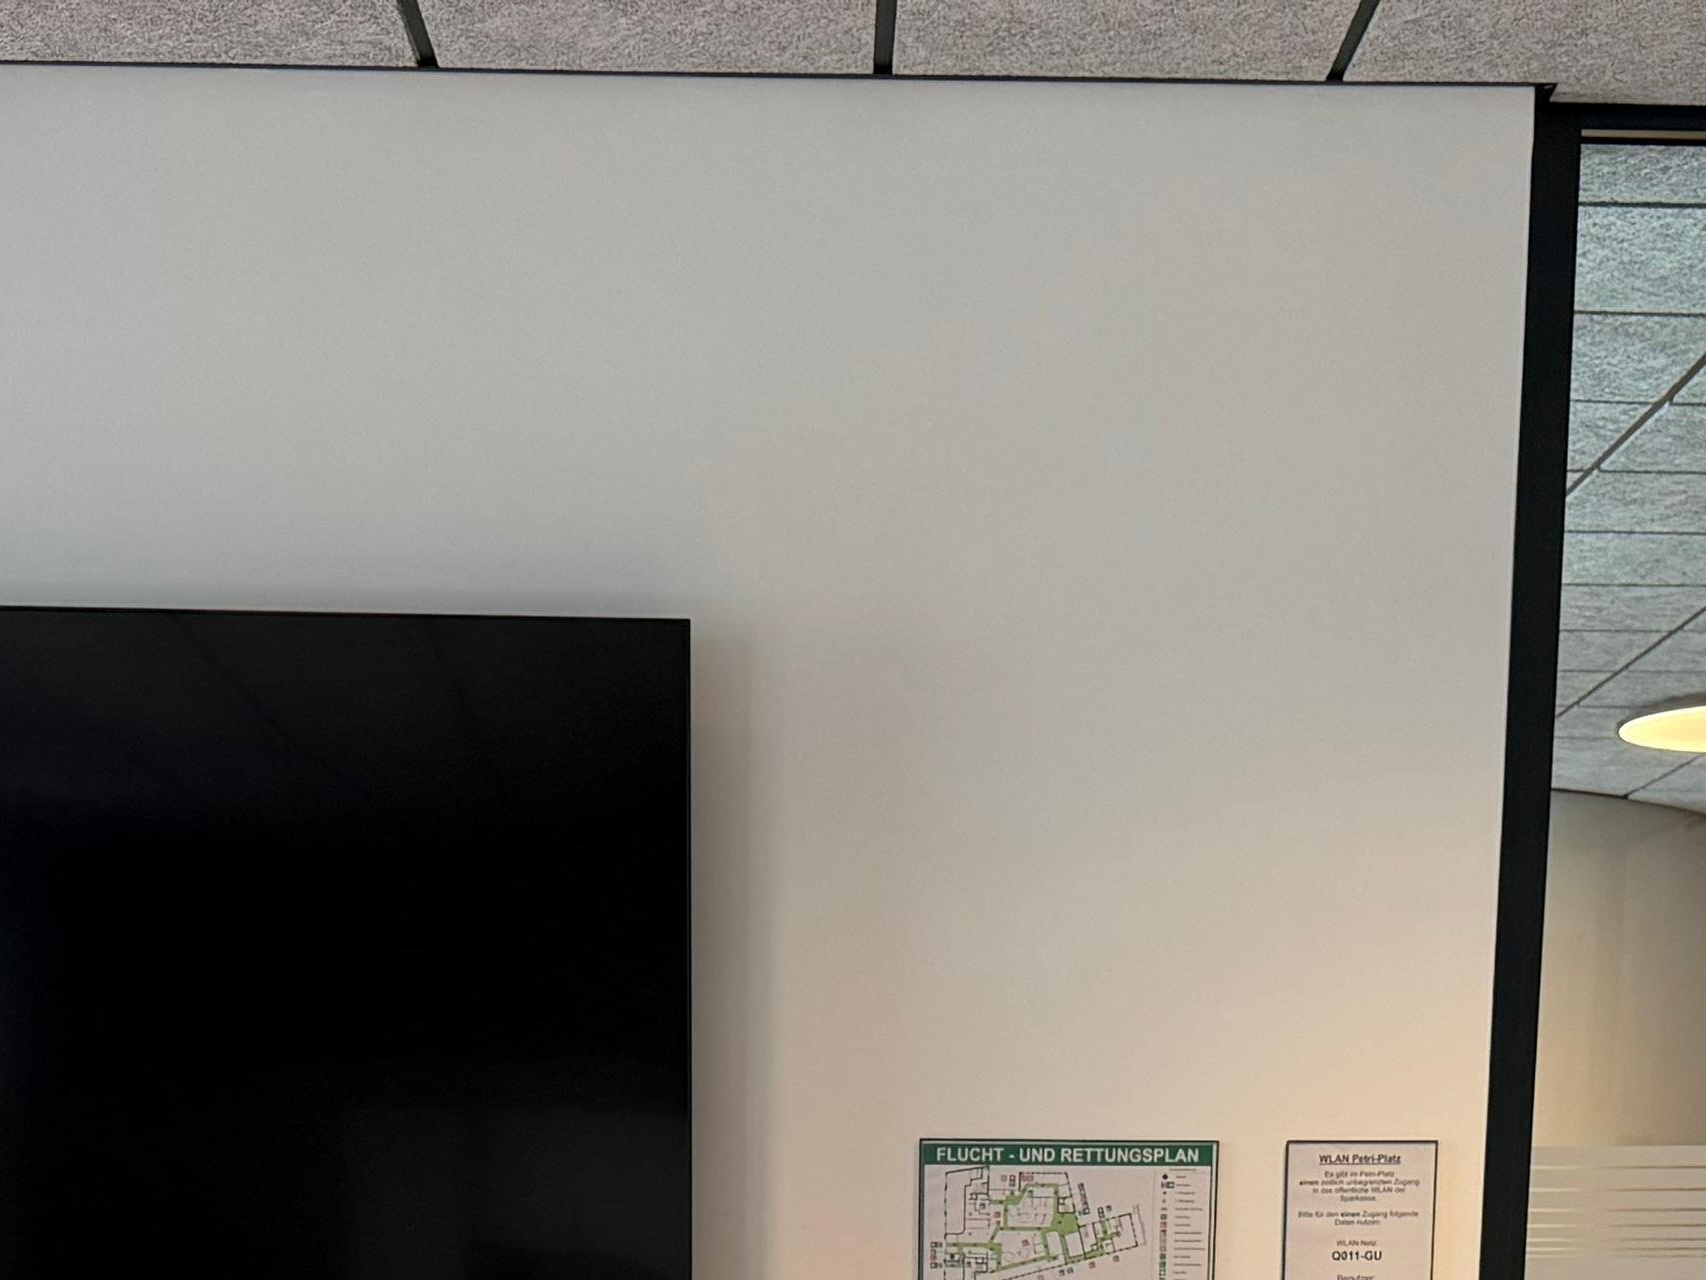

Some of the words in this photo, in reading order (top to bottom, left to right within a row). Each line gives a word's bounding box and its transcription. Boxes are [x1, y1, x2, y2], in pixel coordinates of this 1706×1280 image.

[936, 1147, 1004, 1162] FLUCHT
[1019, 1147, 1056, 1163] UND
[1060, 1147, 1200, 1163] RETTUNGSPLAN
[1319, 1154, 1350, 1164] WLAN
[1351, 1154, 1402, 1164] Petri-Platz
[1331, 1250, 1383, 1261] Q011-GU
